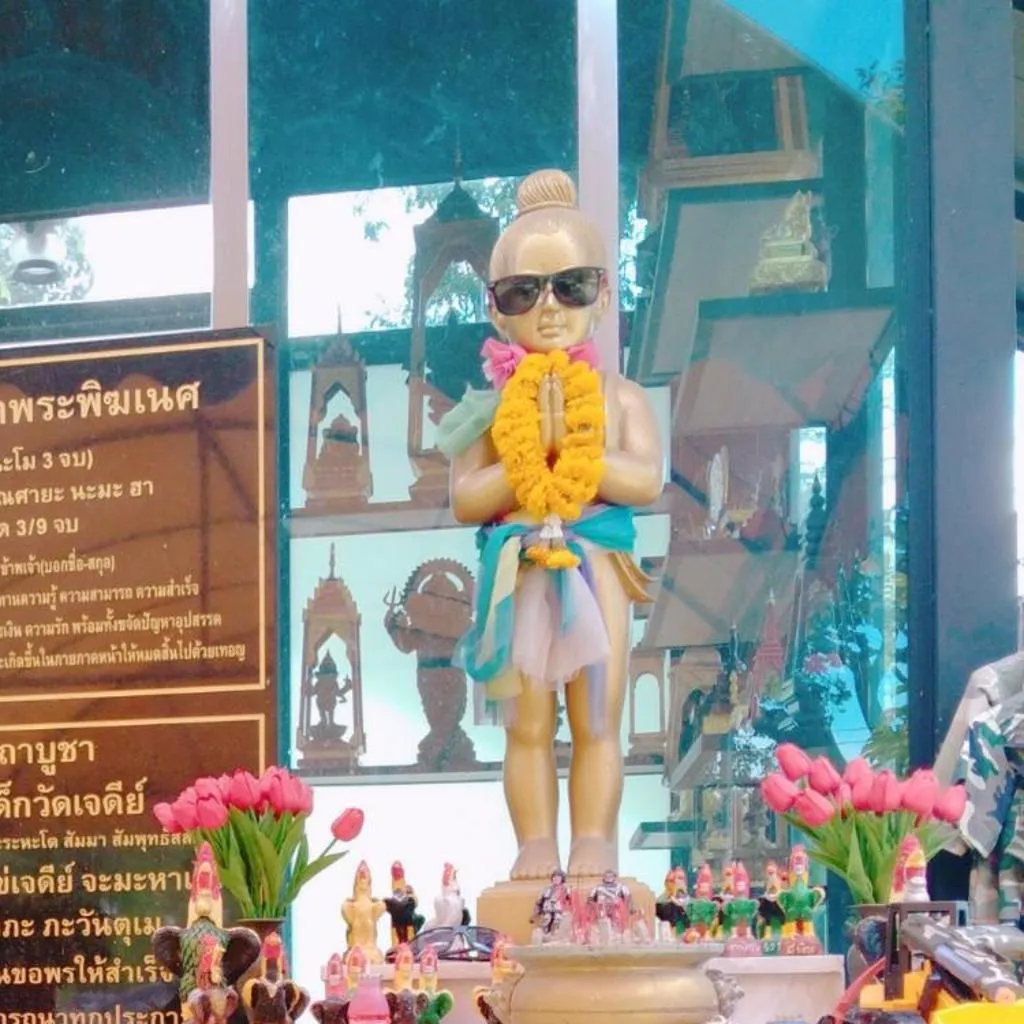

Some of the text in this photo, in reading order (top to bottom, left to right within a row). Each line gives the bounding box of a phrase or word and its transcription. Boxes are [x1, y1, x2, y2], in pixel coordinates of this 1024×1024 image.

[42, 452, 54, 471] 3
[60, 449, 95, 470] จบ)
[71, 484, 124, 502] นะมะ
[130, 480, 154, 497] ฮา
[16, 519, 49, 538] 3/9
[53, 518, 80, 536] จบ
[63, 830, 107, 849] สัมมา
[42, 909, 163, 947] ภะวันตุเม
